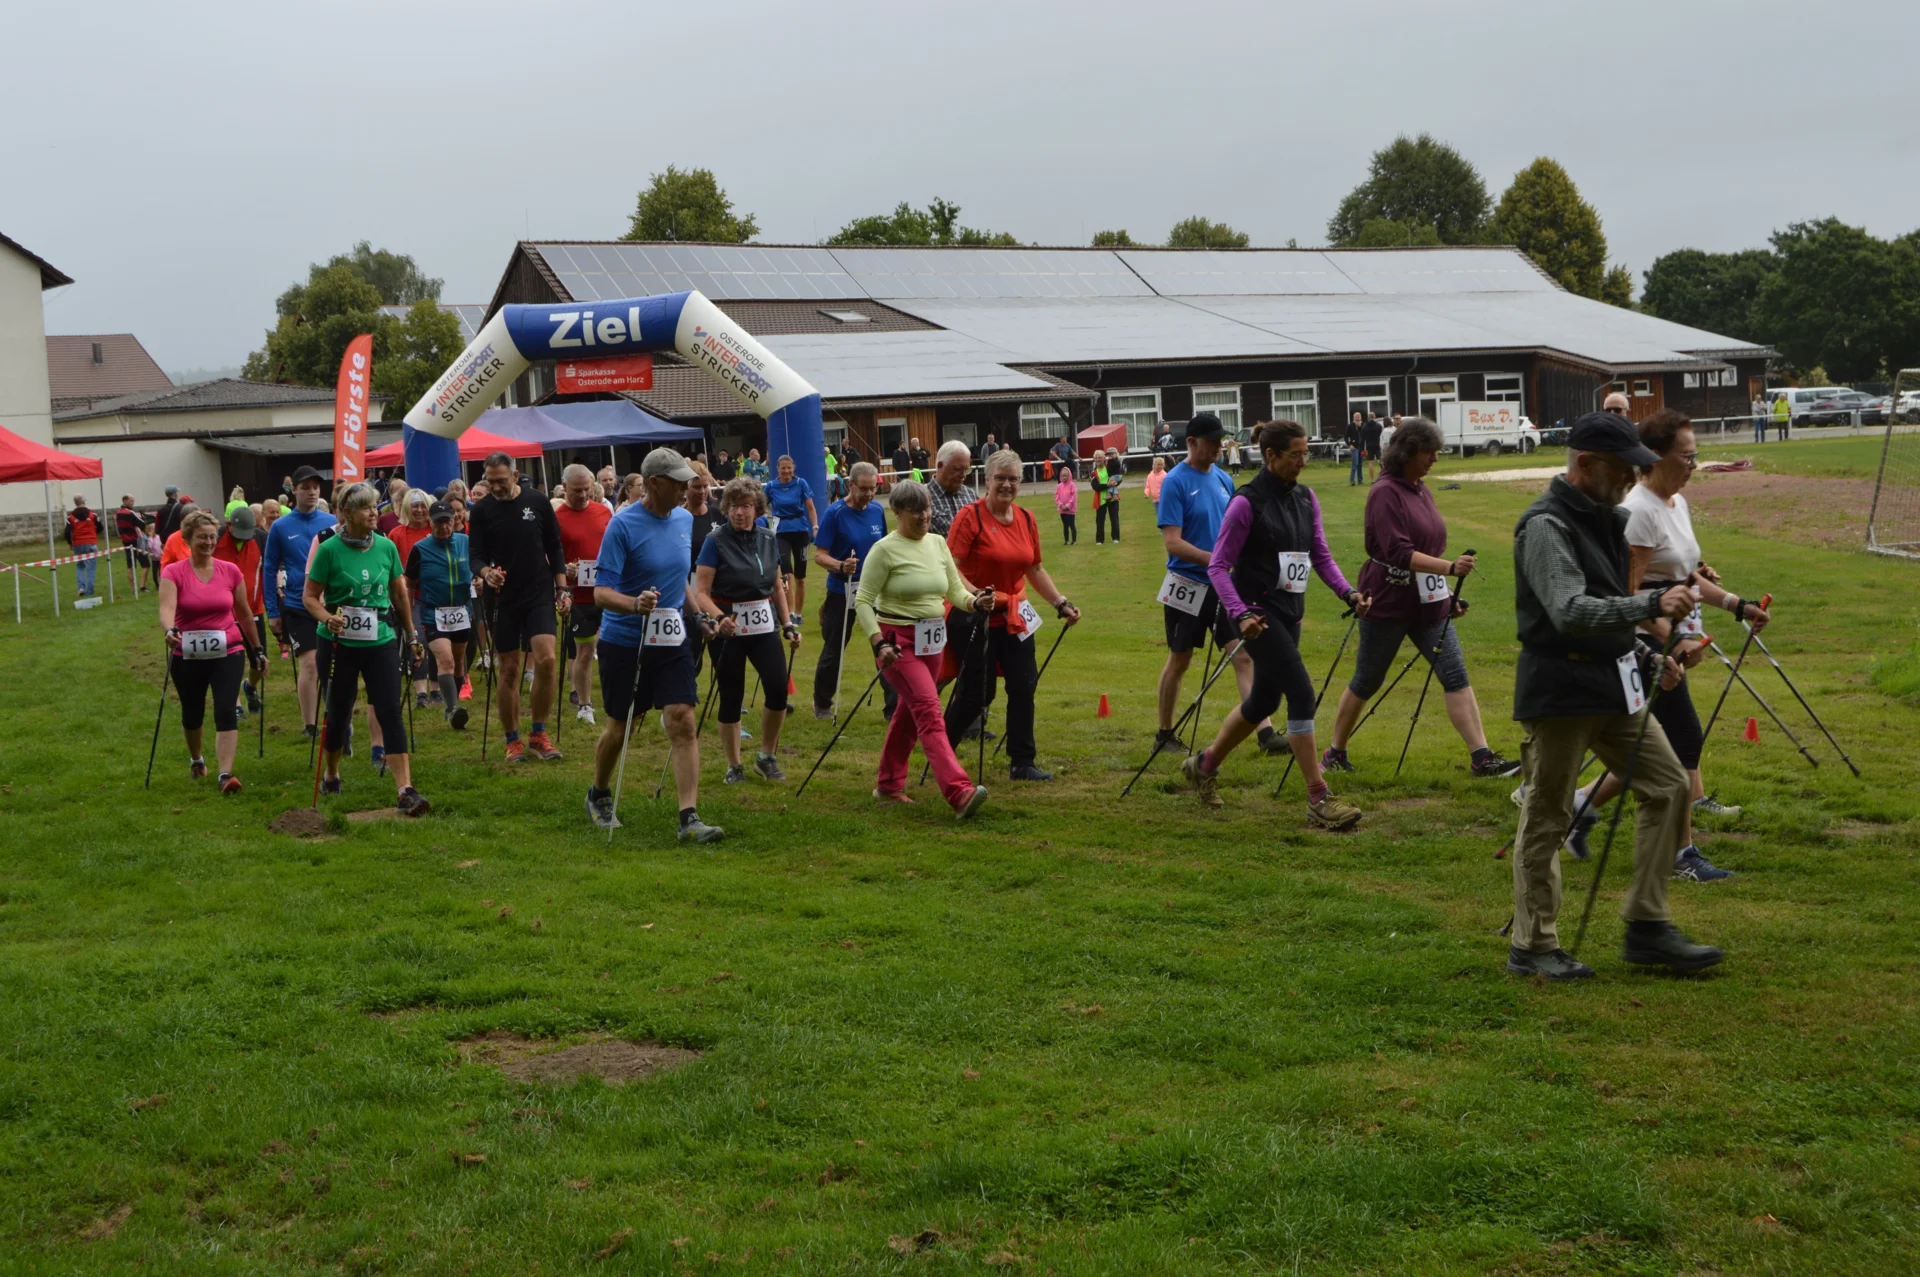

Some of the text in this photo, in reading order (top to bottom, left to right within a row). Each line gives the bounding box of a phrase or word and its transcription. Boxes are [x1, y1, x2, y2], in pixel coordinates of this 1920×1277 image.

[549, 306, 642, 348] Ziel
[704, 335, 773, 394] INTERSPORT
[720, 332, 765, 370] OSTERODE
[435, 343, 496, 407] INTERSPORT
[436, 350, 474, 392] OSTERODE
[578, 368, 616, 377] Sparkasse
[578, 377, 611, 386] Osterode
[627, 376, 645, 384] Harz
[691, 343, 759, 403] STRICKER
[343, 352, 366, 451] Förste
[441, 358, 505, 422] STRICKER
[362, 569, 369, 580] 9
[1169, 582, 1196, 604] 161
[442, 612, 464, 625] 132
[652, 618, 681, 635] 168
[741, 609, 769, 626] 133
[190, 638, 220, 652] 112
